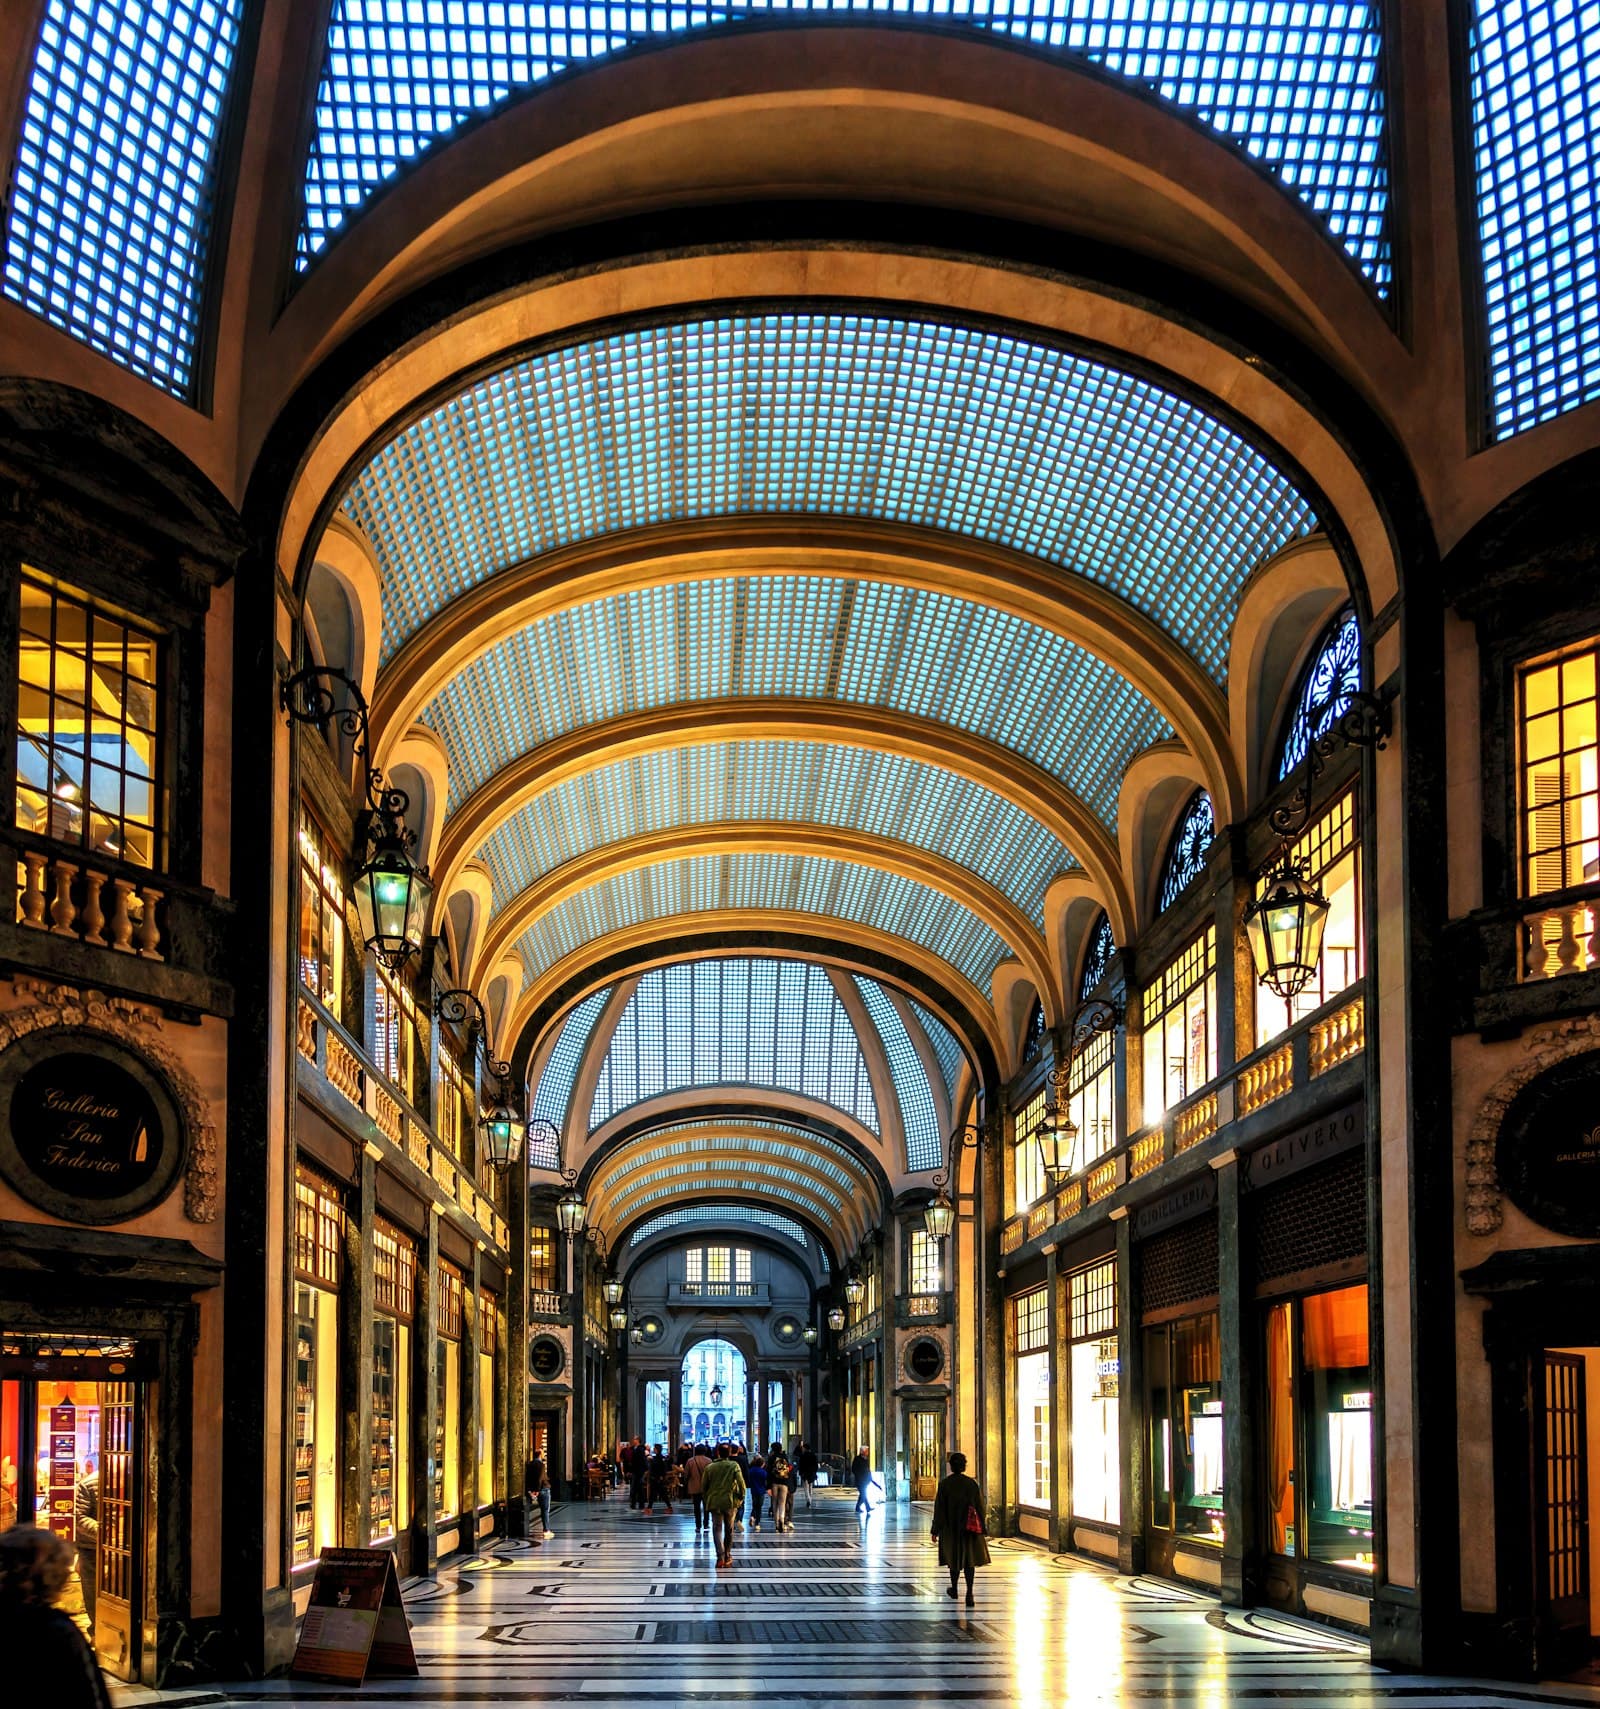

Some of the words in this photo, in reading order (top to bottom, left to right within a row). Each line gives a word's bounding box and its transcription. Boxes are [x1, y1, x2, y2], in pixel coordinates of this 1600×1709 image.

[43, 1087, 120, 1119] Galleria
[61, 1120, 103, 1145] San
[1262, 1114, 1355, 1170] OLIVERO
[43, 1144, 120, 1173] Federico
[1556, 1150, 1596, 1161] GALLERIA
[1140, 1184, 1209, 1227] GIOIELLERIA
